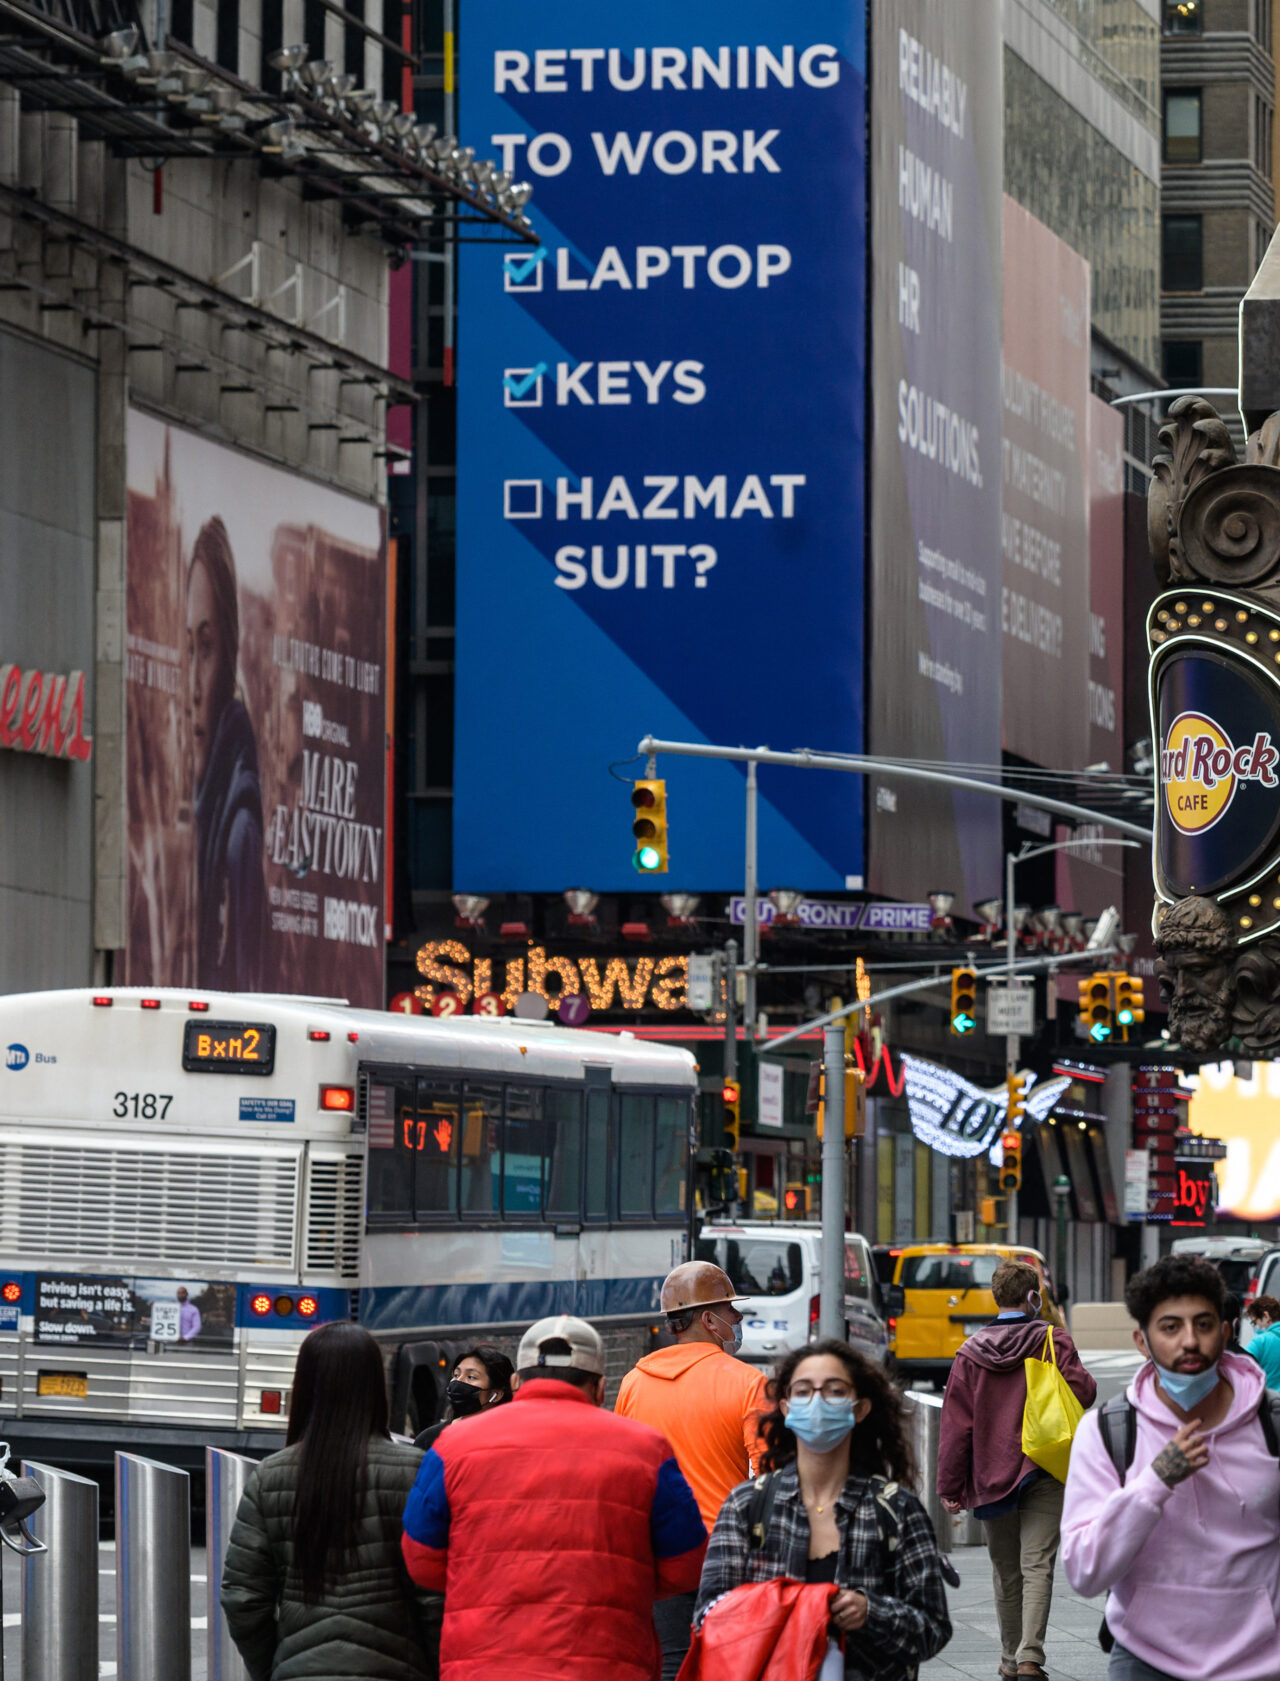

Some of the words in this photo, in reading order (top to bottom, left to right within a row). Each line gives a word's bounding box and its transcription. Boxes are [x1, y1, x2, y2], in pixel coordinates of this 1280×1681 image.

[493, 44, 841, 93] RETURNING
[899, 27, 967, 140] RELIABLY
[492, 132, 572, 177] TO
[591, 129, 781, 175] WORK
[899, 144, 953, 243] HUMAN
[555, 244, 792, 291] LAPTOP
[899, 260, 920, 334] HR
[555, 360, 706, 405] KEYS
[898, 379, 982, 488] SOLUTIONS.
[555, 474, 806, 520] HAZMAT
[554, 545, 719, 590] SUIT?
[303, 699, 323, 739] HBO
[1160, 736, 1190, 784] ard
[1193, 732, 1279, 789] Rock
[300, 749, 358, 820] MARE
[1177, 794, 1208, 811] CAFE
[272, 804, 381, 884] EASTTOWN
[869, 907, 930, 928] PRIME
[439, 996, 457, 1017] 2
[567, 998, 582, 1019] 7
[35, 1053, 57, 1064] Bus
[198, 1029, 260, 1060] BxM2
[113, 1092, 173, 1120] 3187
[40, 1281, 77, 1297] Driving
[79, 1282, 102, 1296] isn't
[40, 1296, 58, 1308] but
[60, 1298, 94, 1312] saving
[95, 1301, 101, 1310] a
[103, 1298, 120, 1311] life
[122, 1299, 135, 1312] is.
[39, 1320, 63, 1334] Slow
[65, 1322, 96, 1335] down.
[154, 1322, 177, 1336] 25
